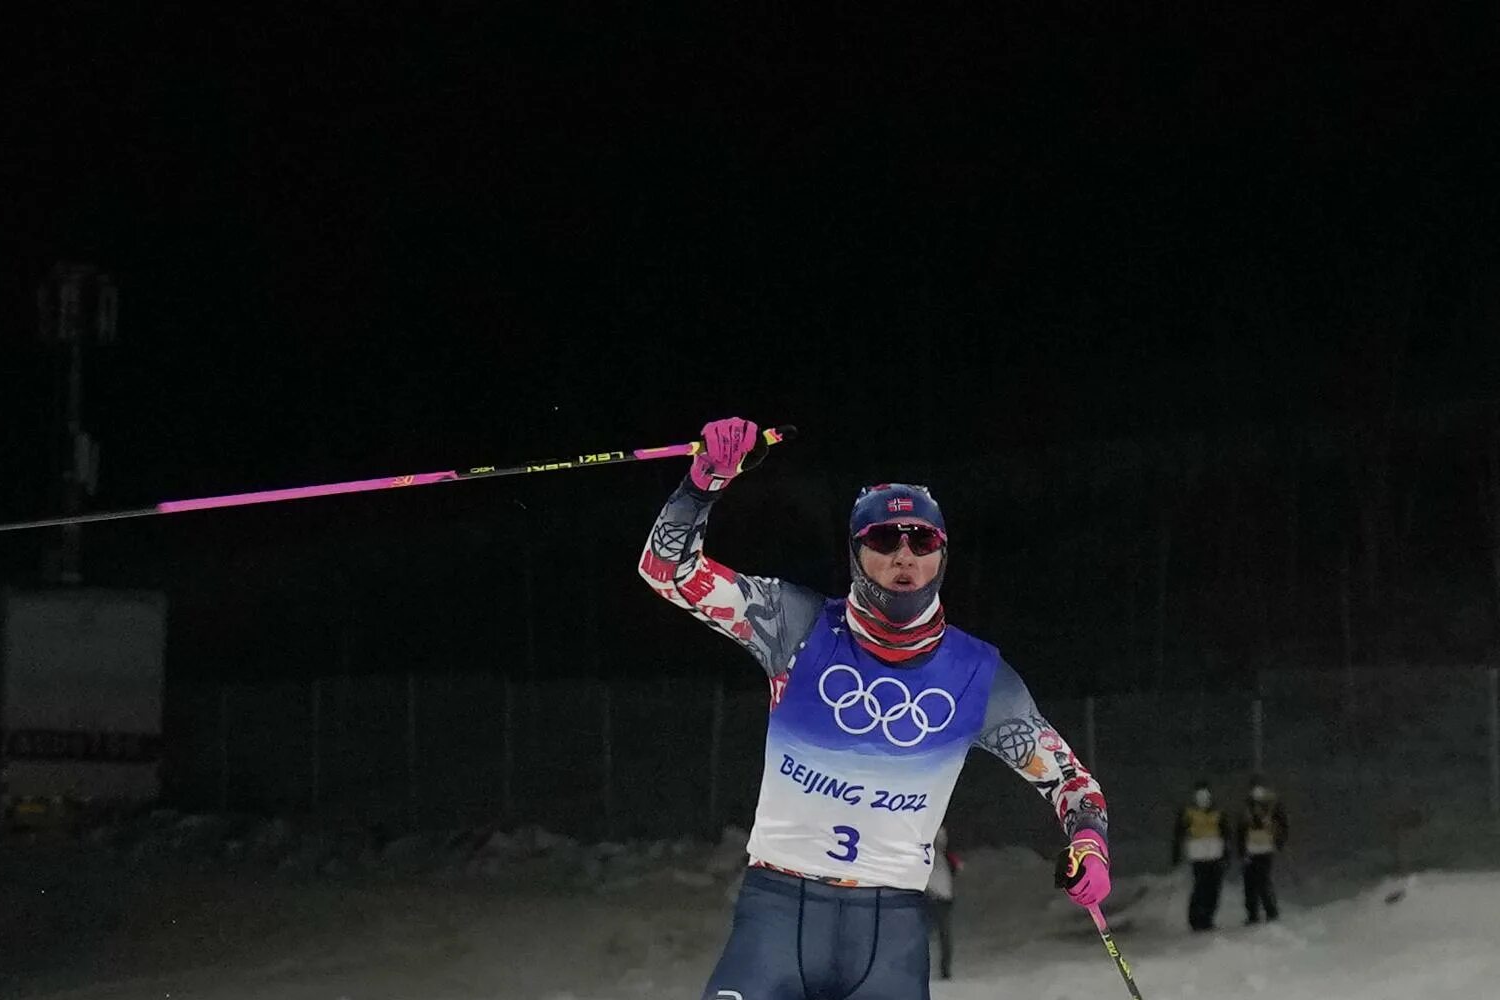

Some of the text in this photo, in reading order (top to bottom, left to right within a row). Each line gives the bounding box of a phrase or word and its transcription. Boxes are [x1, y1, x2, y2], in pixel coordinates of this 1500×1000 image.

[779, 754, 928, 812] BEIJING 2022
[826, 825, 861, 863] 3
